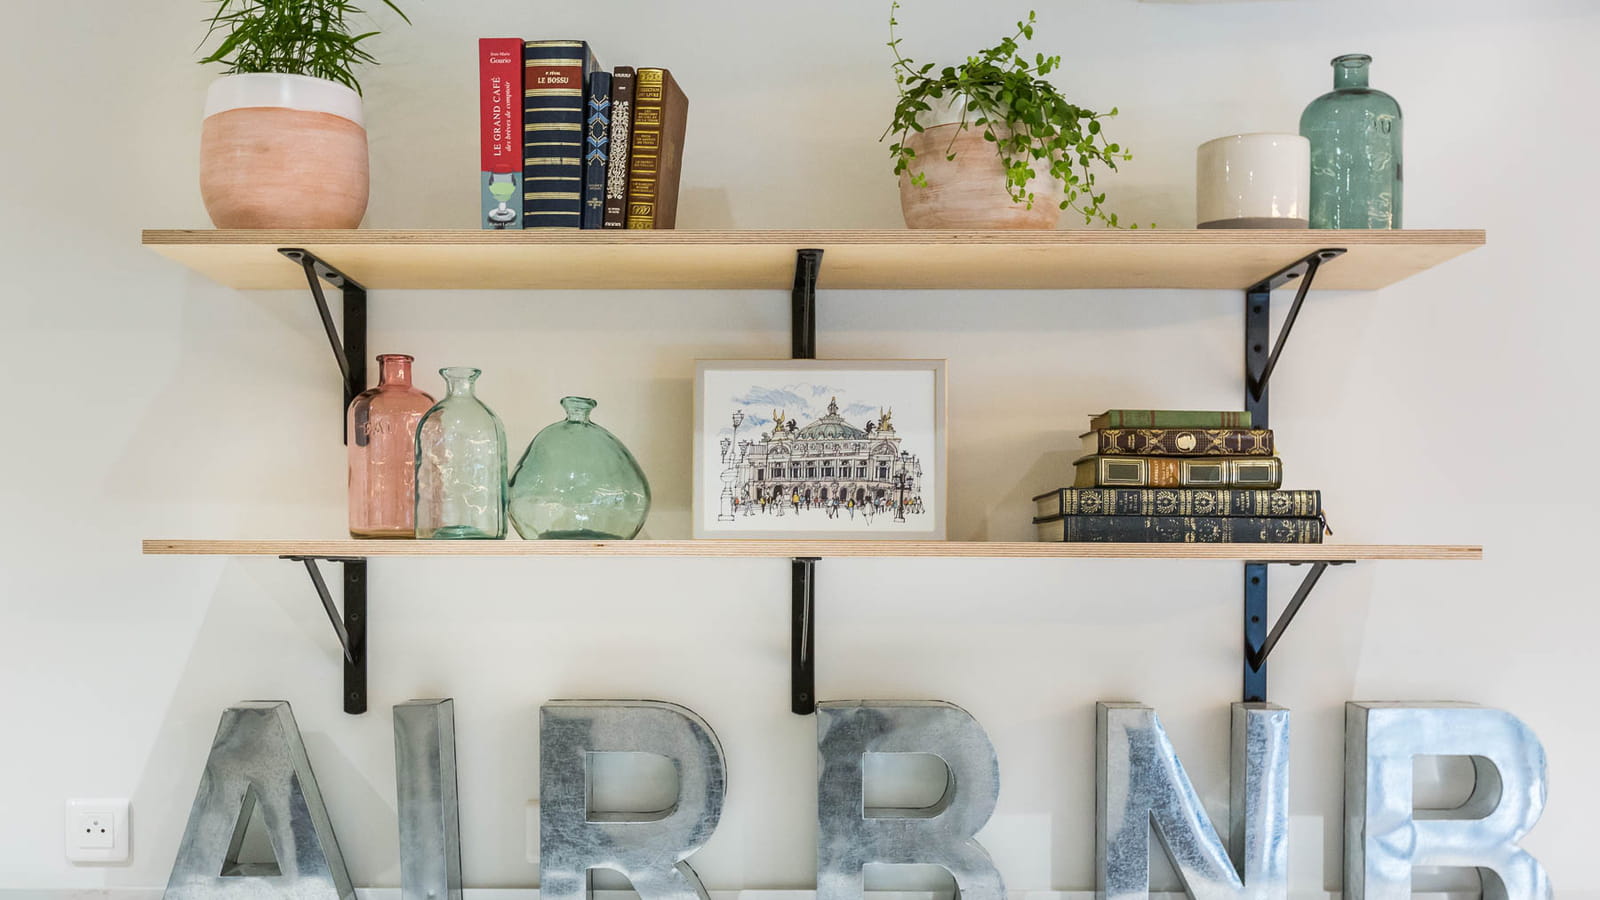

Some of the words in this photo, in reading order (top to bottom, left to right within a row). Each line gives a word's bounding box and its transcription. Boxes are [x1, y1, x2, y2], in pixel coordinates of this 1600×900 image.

[491, 76, 501, 103] CAFÉ
[493, 105, 501, 141] GRAND
[504, 110, 511, 119] de
[493, 143, 502, 156] LE
